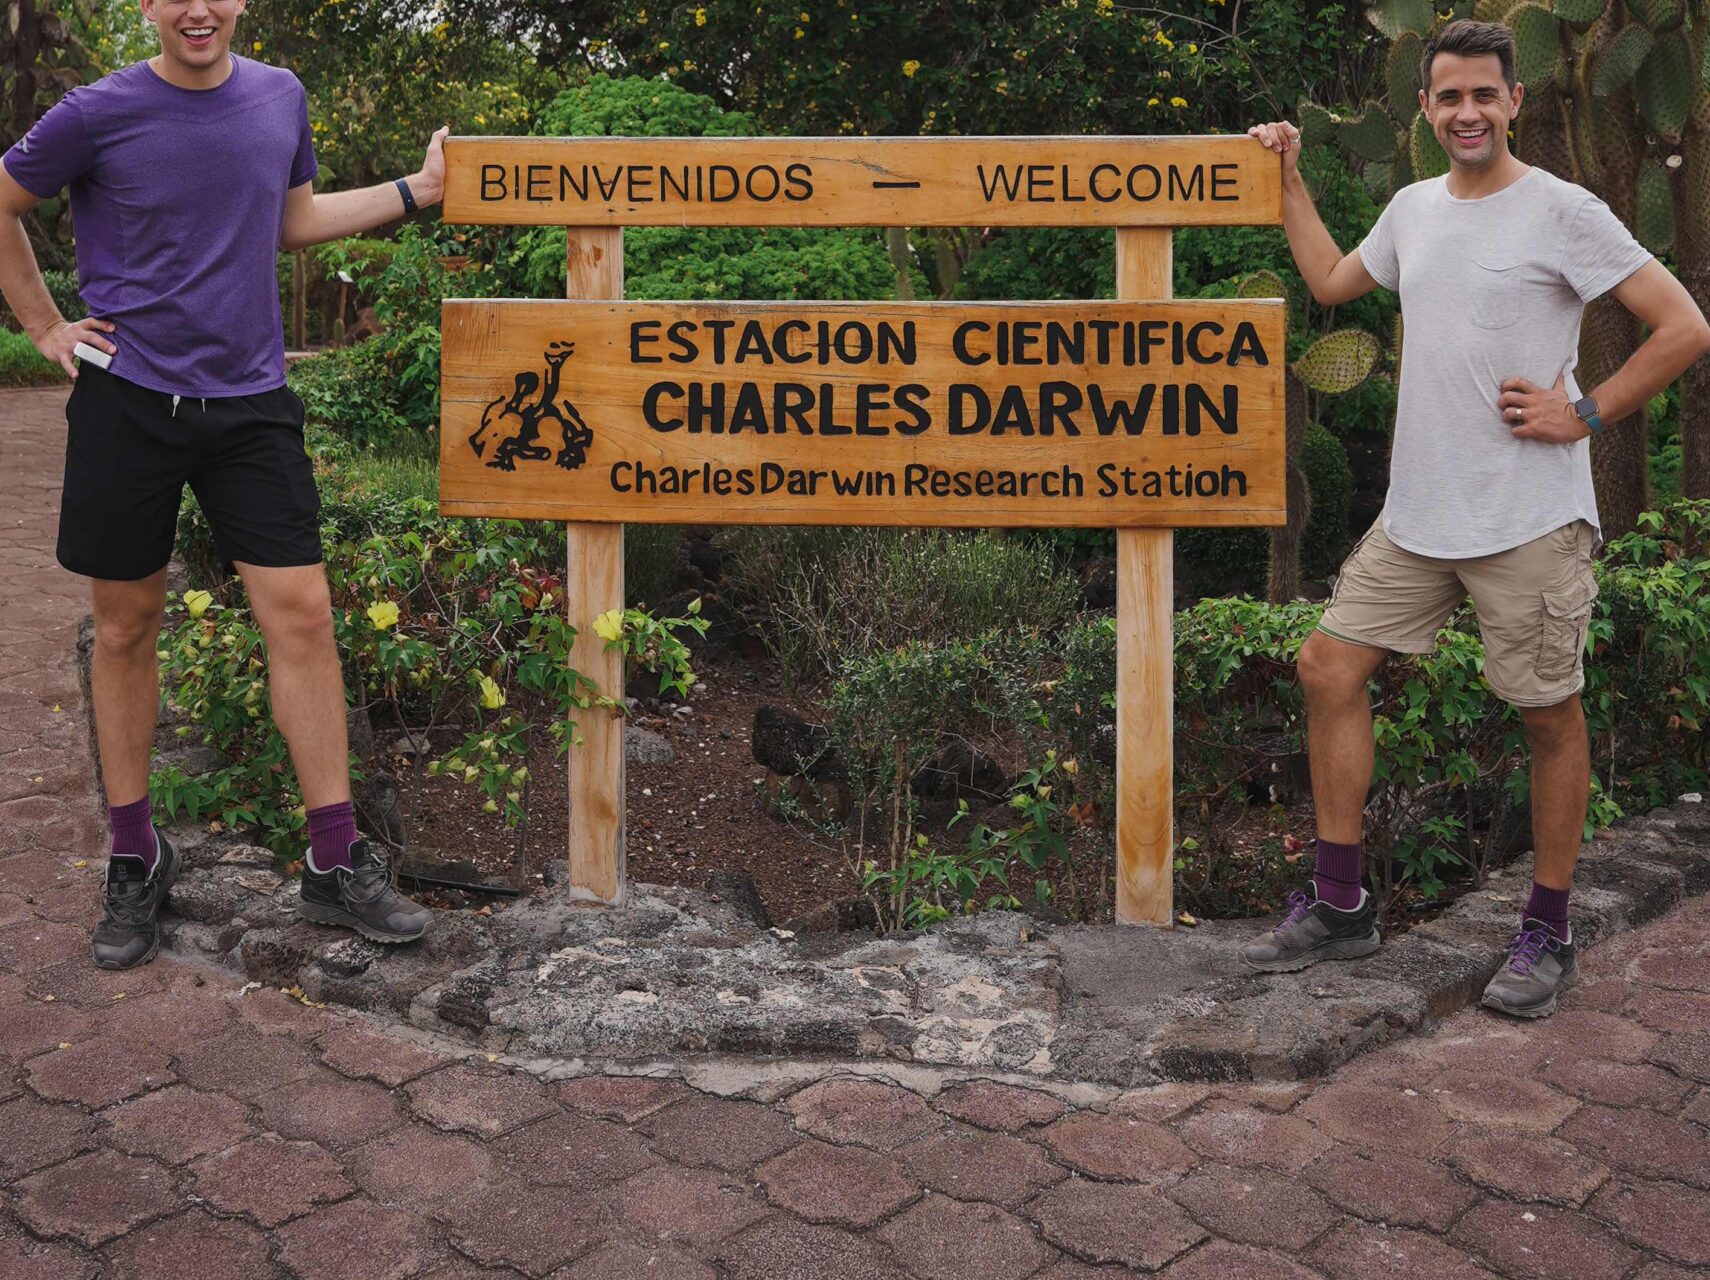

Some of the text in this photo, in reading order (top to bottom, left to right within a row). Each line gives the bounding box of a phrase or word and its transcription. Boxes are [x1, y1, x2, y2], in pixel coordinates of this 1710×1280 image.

[480, 163, 813, 202] BIENVENIDOS
[977, 163, 1239, 202] WELCOME
[629, 319, 1269, 367] ESTACION CIENTIFICA
[642, 380, 1239, 437] CHARLES DARWIN
[904, 463, 1084, 497] Research
